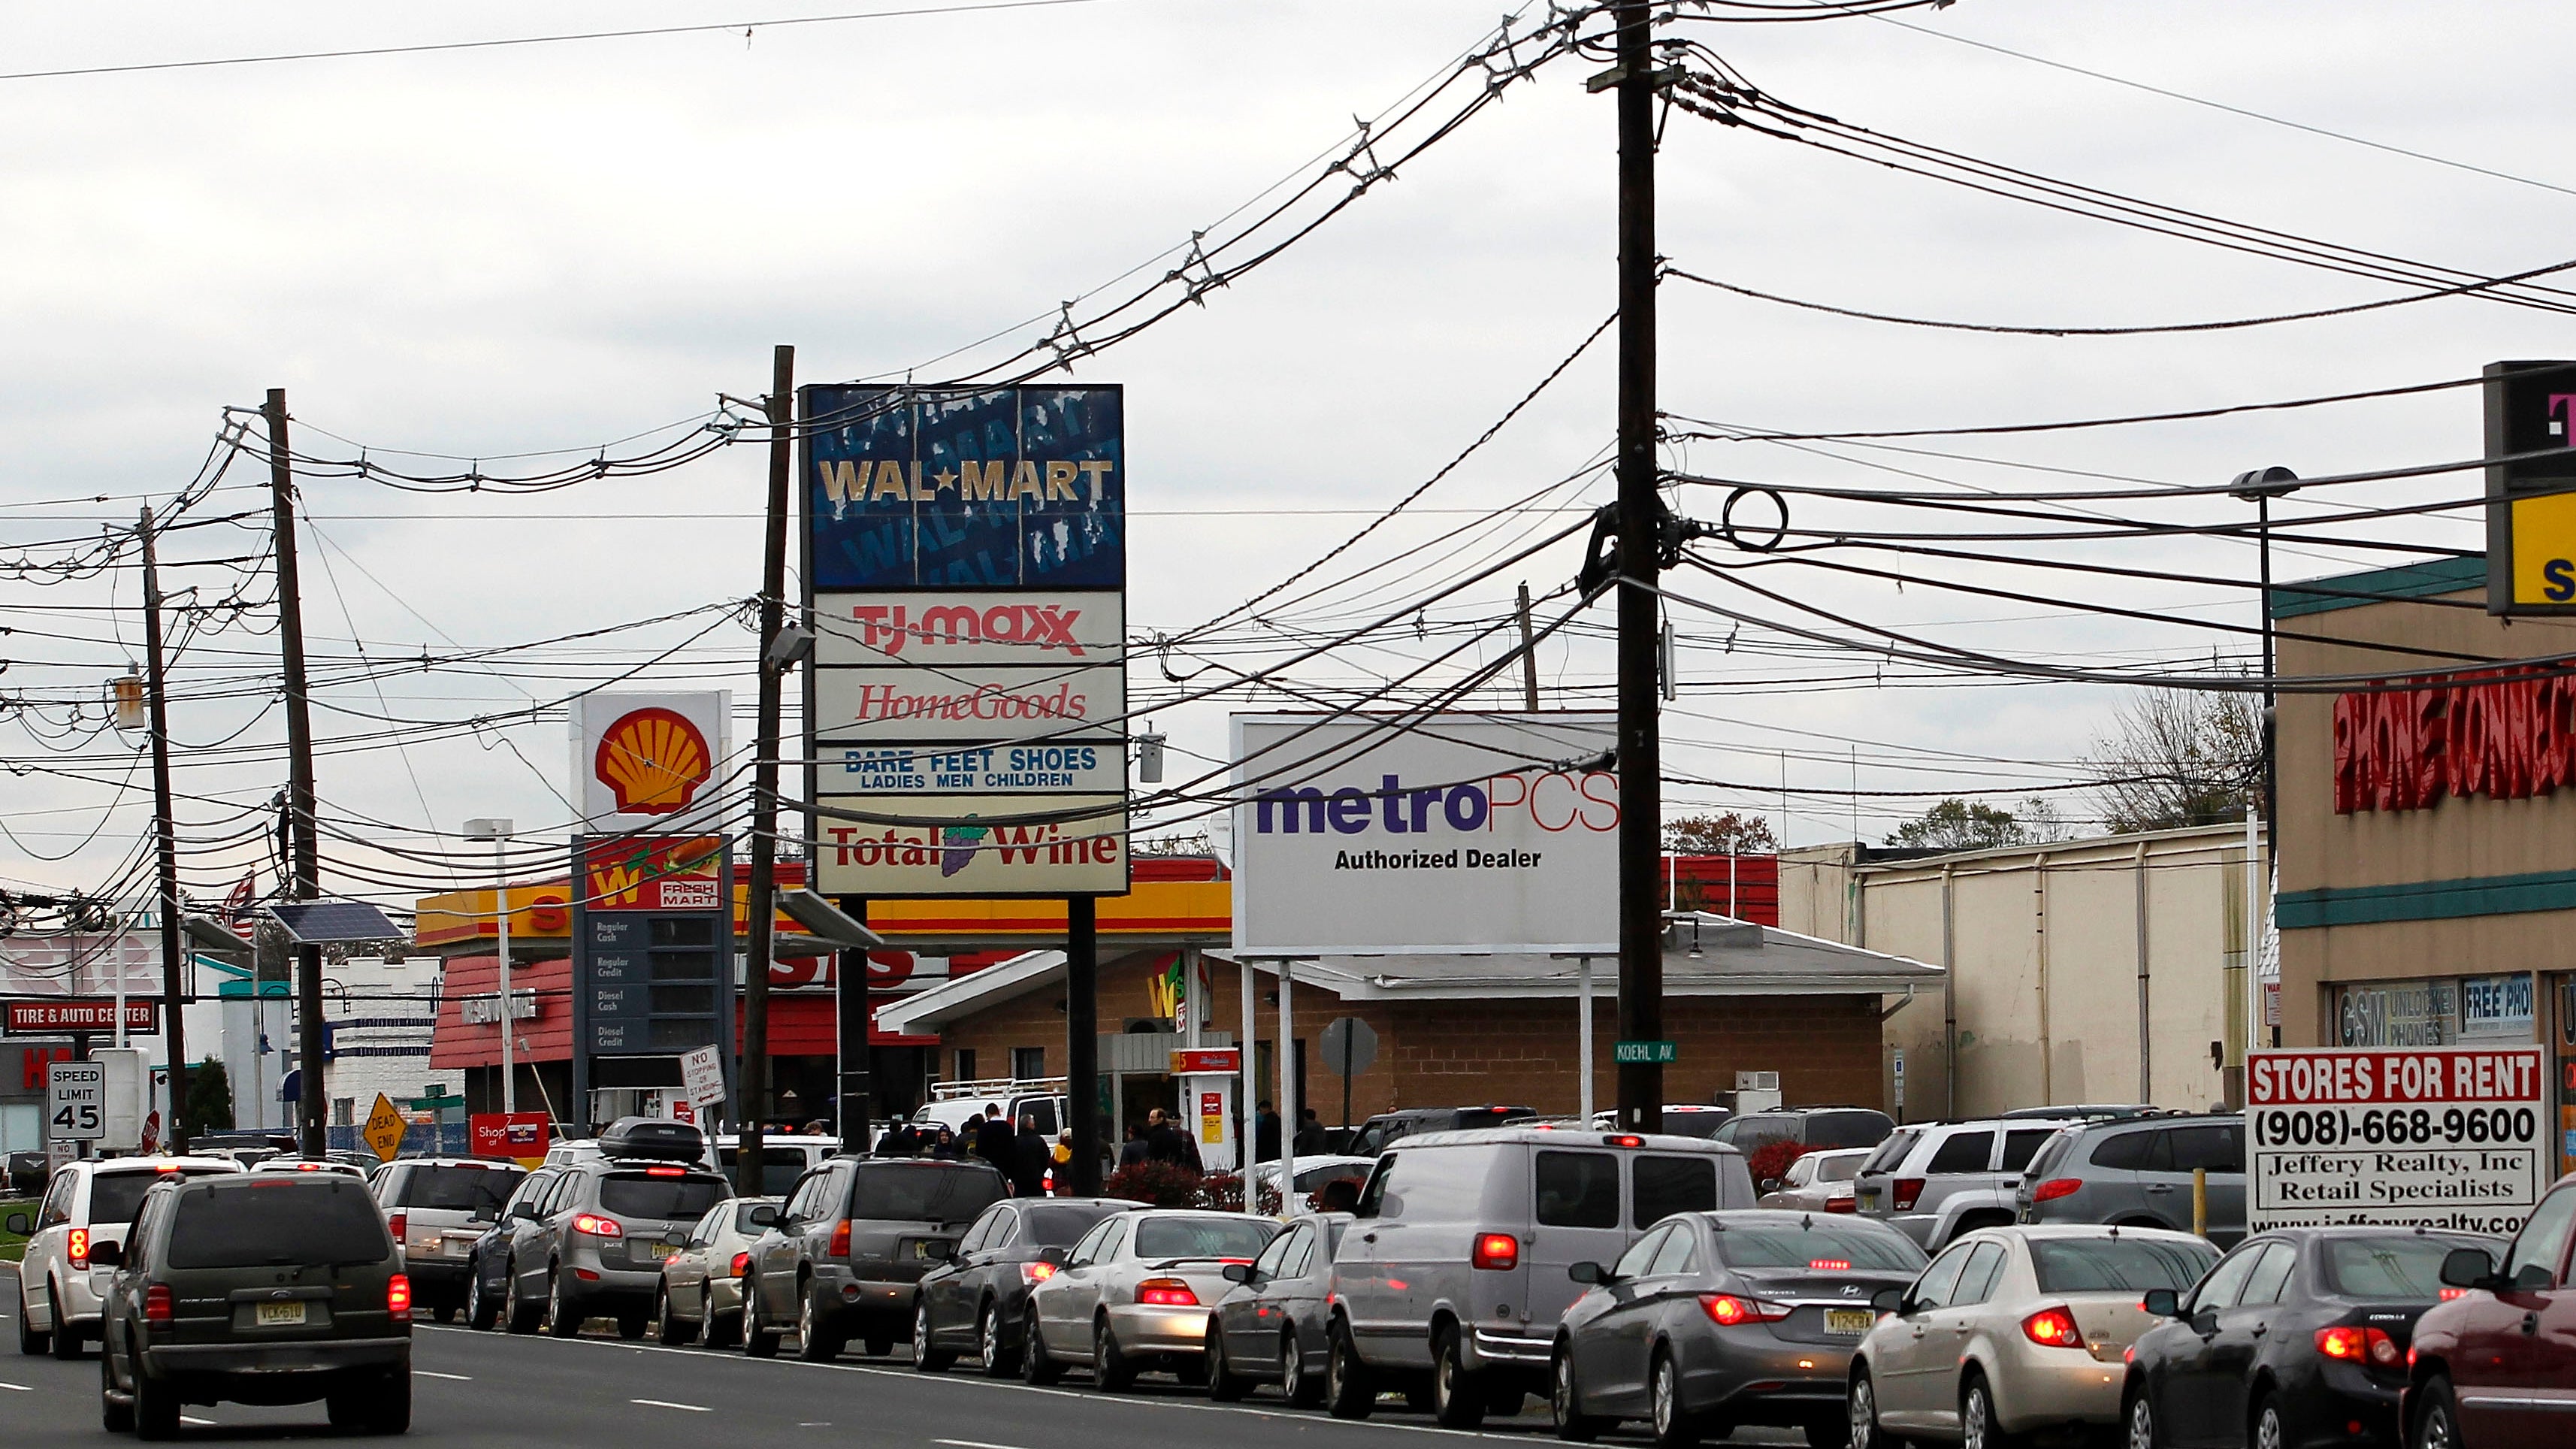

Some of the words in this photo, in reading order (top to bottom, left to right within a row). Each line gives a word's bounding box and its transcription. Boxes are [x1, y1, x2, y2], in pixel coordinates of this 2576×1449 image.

[855, 682, 1087, 721] HomeGoods
[2334, 673, 2447, 814] PHONE
[845, 750, 914, 773] BARE
[930, 749, 994, 772] FEET
[1010, 748, 1096, 771] SHOES
[861, 774, 925, 788] LADIES
[937, 773, 974, 788] MEN
[985, 773, 1073, 787] CHILDREN
[827, 826, 939, 866] Total
[990, 824, 1118, 865] Wine
[1334, 850, 1458, 870] Authorized
[1466, 849, 1542, 869] Dealer
[664, 885, 713, 894] FRESH
[664, 896, 713, 905] MART
[597, 922, 628, 933] Regular
[597, 933, 616, 942] Cash
[597, 957, 629, 968] Regular
[598, 968, 622, 977] Credit
[598, 991, 623, 1000] Diesel
[2466, 985, 2501, 1018] FREE
[2506, 982, 2533, 1017] PHO
[598, 1002, 617, 1011] Cash
[15, 1009, 44, 1023] TIRE
[48, 1009, 57, 1023] &
[60, 1008, 94, 1023] AUTO
[98, 1008, 149, 1022] CETER
[2339, 991, 2387, 1048] GSM
[2390, 986, 2457, 1018] UNLOCKED
[598, 1027, 624, 1036] Diesel
[2390, 1021, 2441, 1046] PHONES
[599, 1038, 623, 1046] Credit
[692, 1052, 708, 1066] NO
[1617, 1044, 1651, 1060] KOEHL
[53, 1071, 99, 1082] SPEED
[2254, 1056, 2372, 1102] STORES
[2384, 1056, 2443, 1100] FOR
[2454, 1054, 2535, 1099] RENT
[59, 1090, 94, 1100] LIMIT
[53, 1105, 99, 1129] 45
[371, 1114, 395, 1130] DEAD
[479, 1126, 506, 1139] Shop
[2255, 1108, 2535, 1147] (908)-668-9600
[378, 1133, 395, 1149] END
[58, 1145, 70, 1153] NO
[2268, 1154, 2364, 1176] Jeffery
[2375, 1153, 2469, 1175] Realty,
[2479, 1152, 2523, 1172] Inc
[2279, 1181, 2361, 1201] Retail
[2369, 1179, 2514, 1202] Specialists
